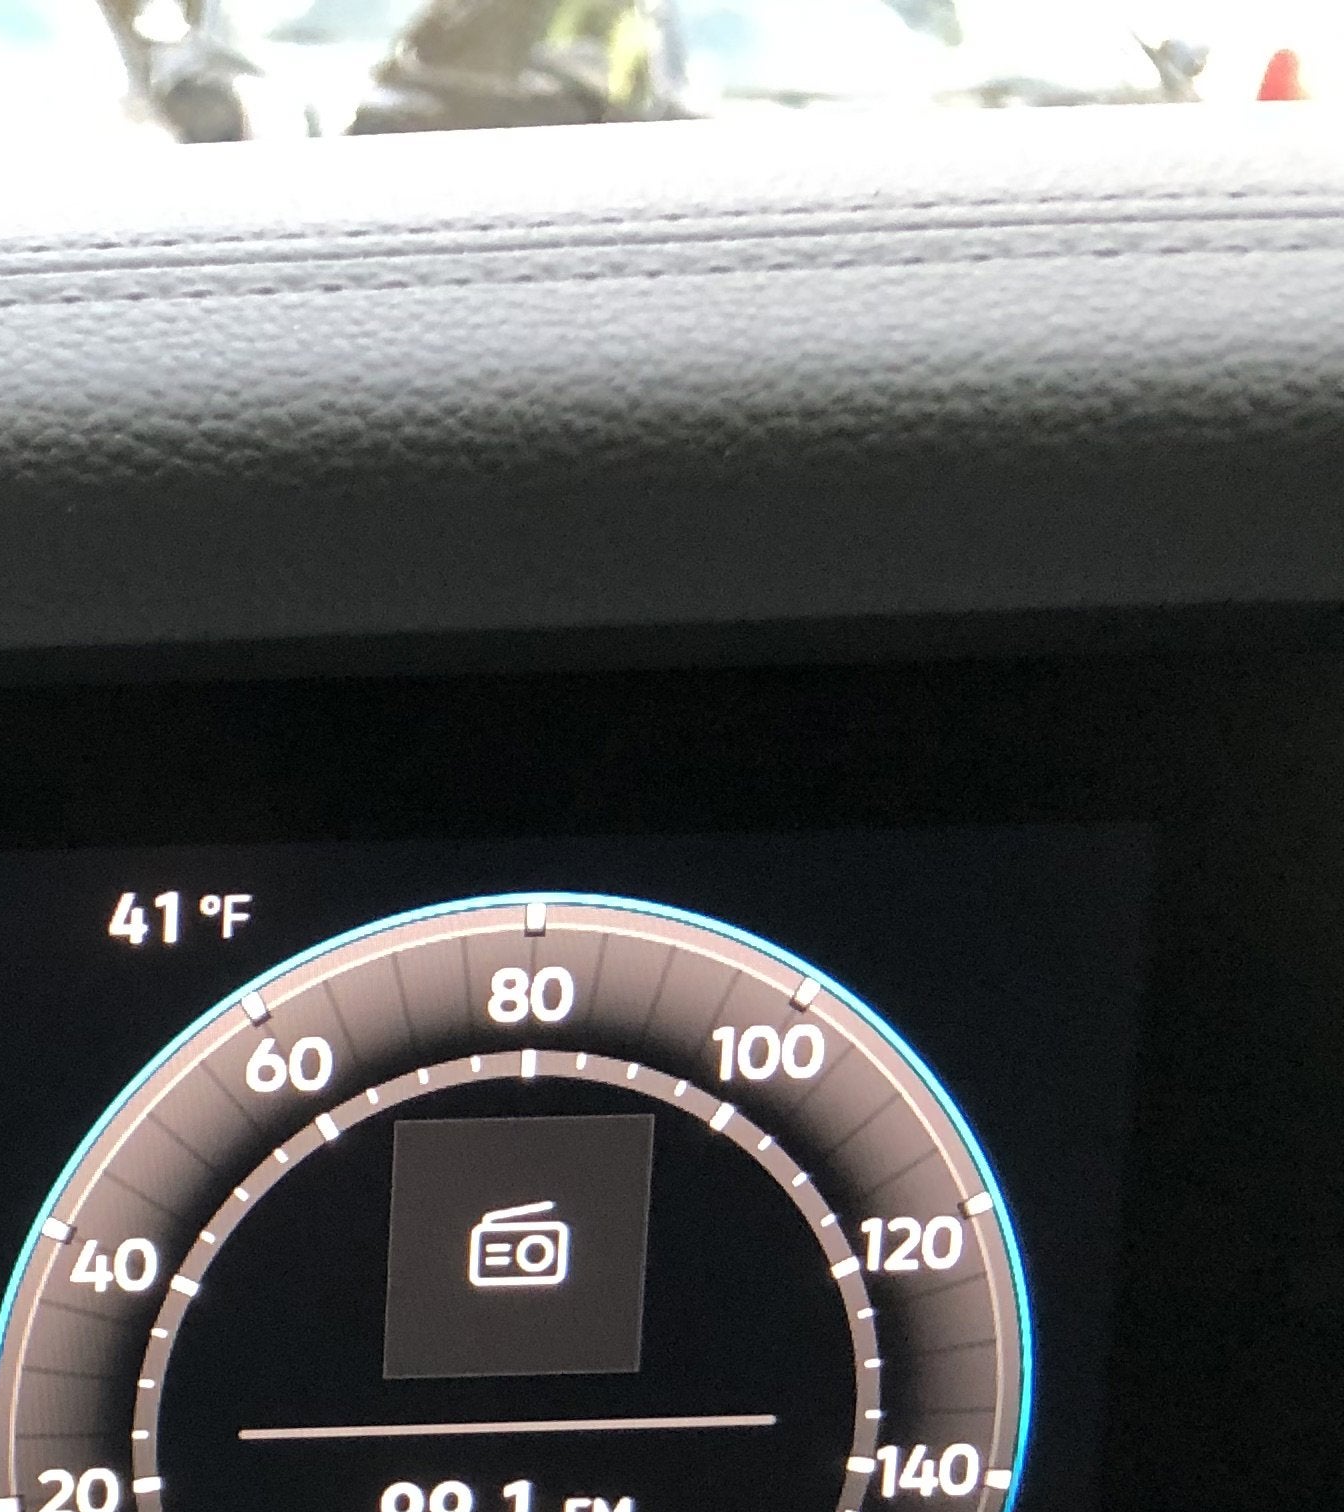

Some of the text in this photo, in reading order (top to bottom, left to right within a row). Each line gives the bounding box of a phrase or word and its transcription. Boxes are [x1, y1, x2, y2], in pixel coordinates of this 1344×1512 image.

[107, 891, 253, 945] 41 °F
[487, 966, 575, 1023] 80
[244, 1036, 333, 1093] 60
[711, 1024, 825, 1081] 100
[69, 1237, 158, 1293] 40
[861, 1215, 965, 1272] 120
[877, 1443, 981, 1499] 140
